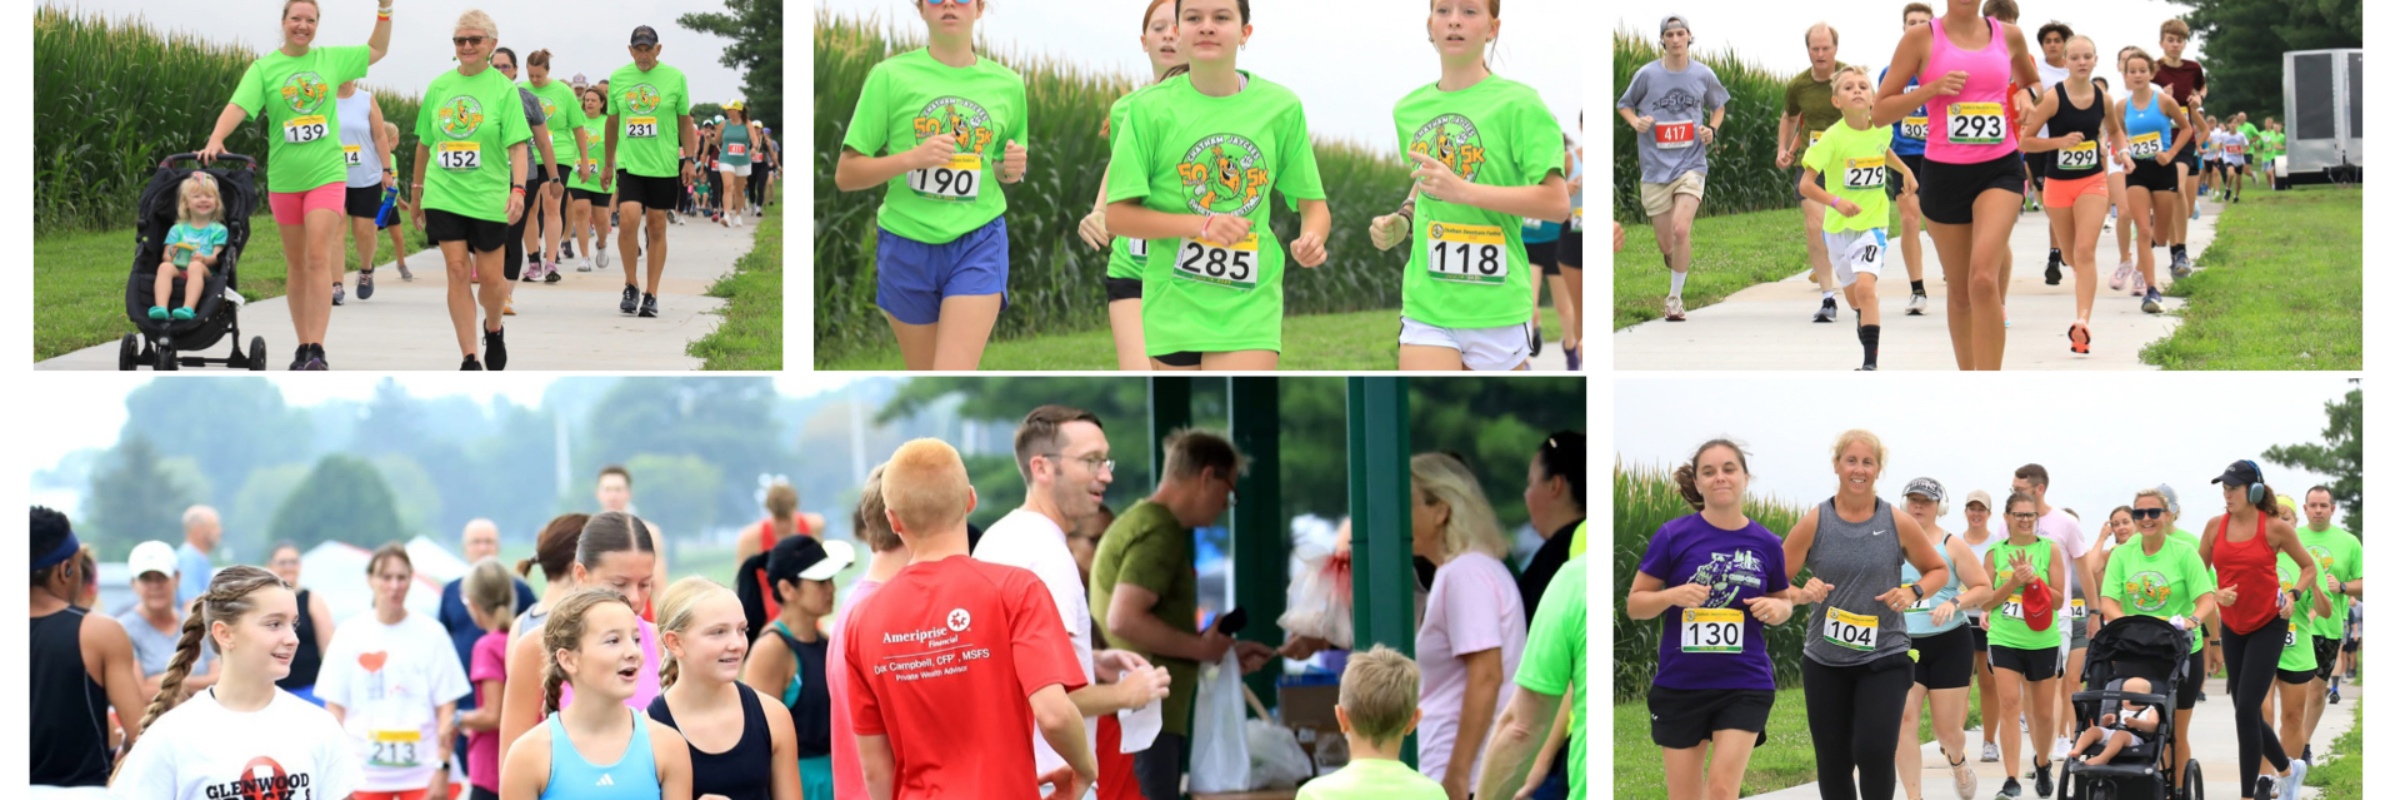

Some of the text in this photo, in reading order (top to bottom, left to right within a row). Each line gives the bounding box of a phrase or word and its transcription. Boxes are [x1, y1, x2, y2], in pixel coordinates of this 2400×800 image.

[290, 124, 324, 141] 139
[629, 123, 652, 136] 231
[913, 116, 994, 145] 50 5K
[1664, 125, 1686, 141] 417
[1954, 115, 2001, 137] 293
[1187, 136, 1260, 161] CHATHAM JAYCEES
[1460, 144, 1486, 164] 5K
[2063, 150, 2094, 165] 299
[2133, 140, 2159, 155] 235
[442, 150, 476, 168] 152
[916, 168, 973, 196] 190
[1176, 162, 1269, 187] 50 5K
[1849, 166, 1883, 186] 279
[1182, 242, 1250, 280] 285
[1435, 241, 1499, 275] 118
[883, 627, 947, 644] Ameriprise
[928, 635, 958, 648] Financial
[1689, 622, 1738, 646] 130
[1831, 621, 1871, 645] 104
[962, 648, 990, 661] MSFS
[895, 672, 919, 682] Private
[944, 665, 968, 675] Advisor
[373, 741, 416, 762] 213
[206, 773, 309, 799] GLENWOOD
